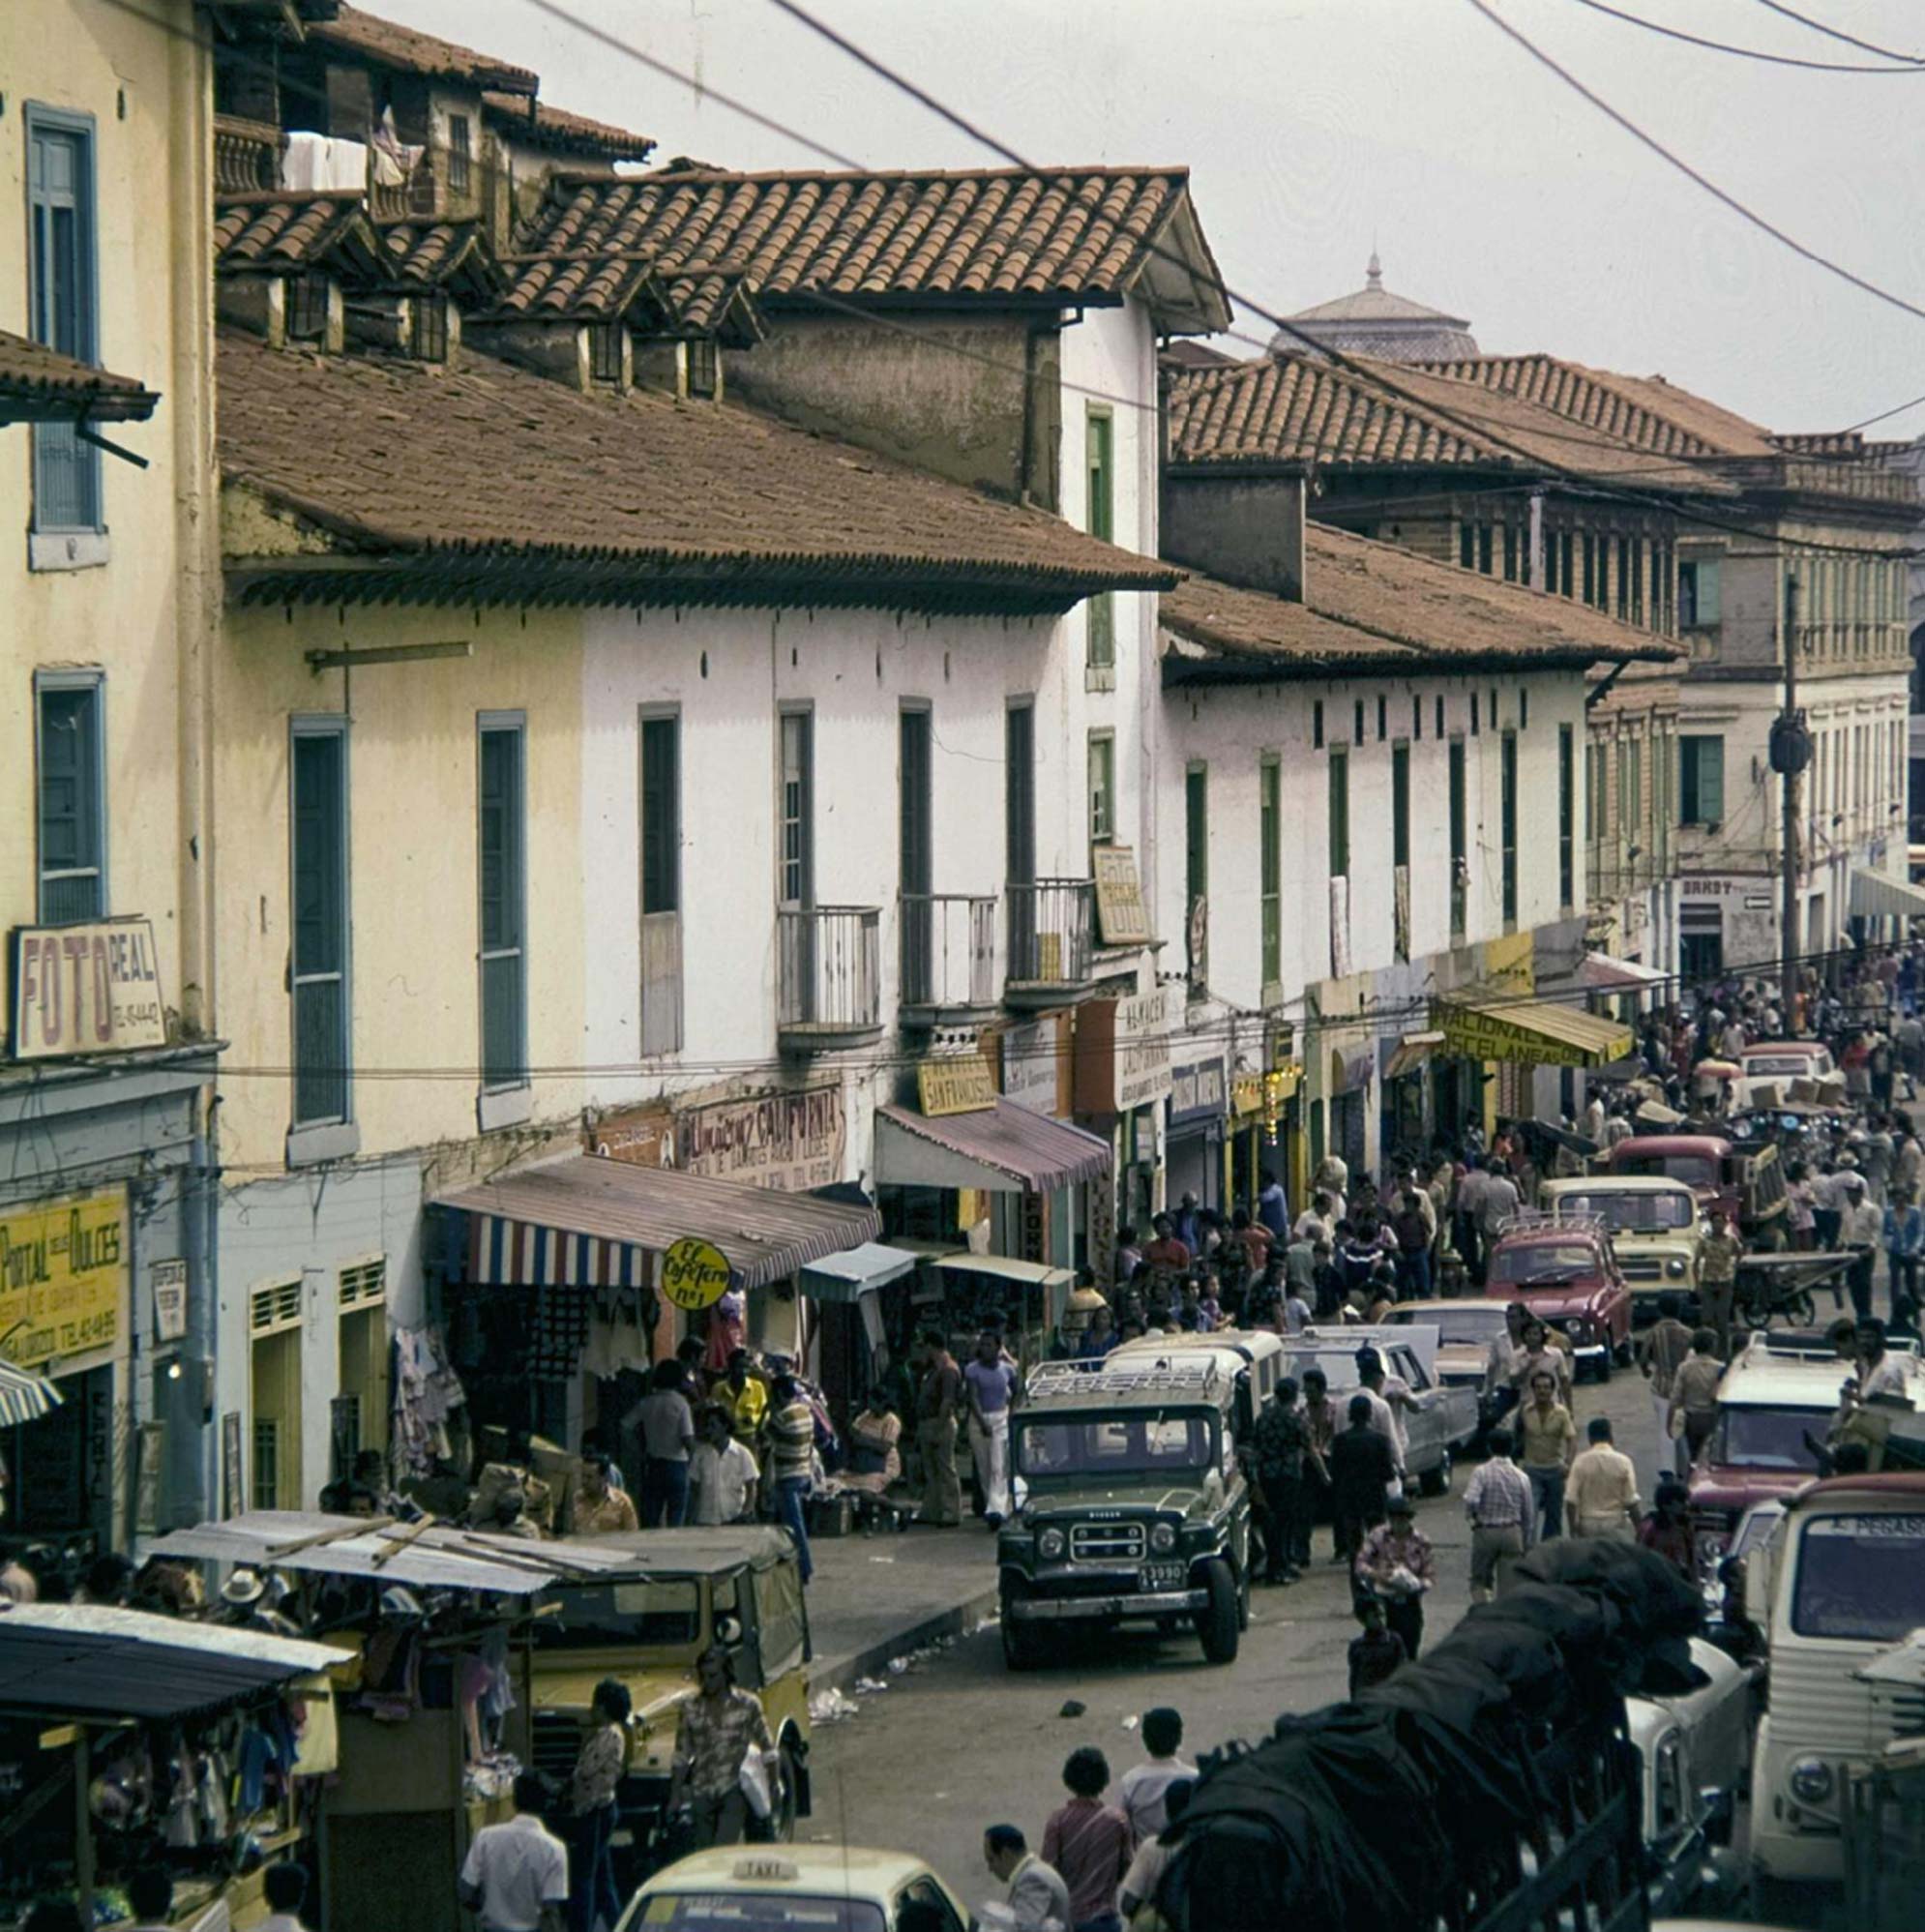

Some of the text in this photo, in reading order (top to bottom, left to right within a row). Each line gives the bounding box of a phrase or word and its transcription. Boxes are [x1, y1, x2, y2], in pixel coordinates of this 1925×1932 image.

[21, 934, 154, 1048] FOTO REAL
[680, 1240, 704, 1258] El
[745, 1862, 782, 1878] TAXI
